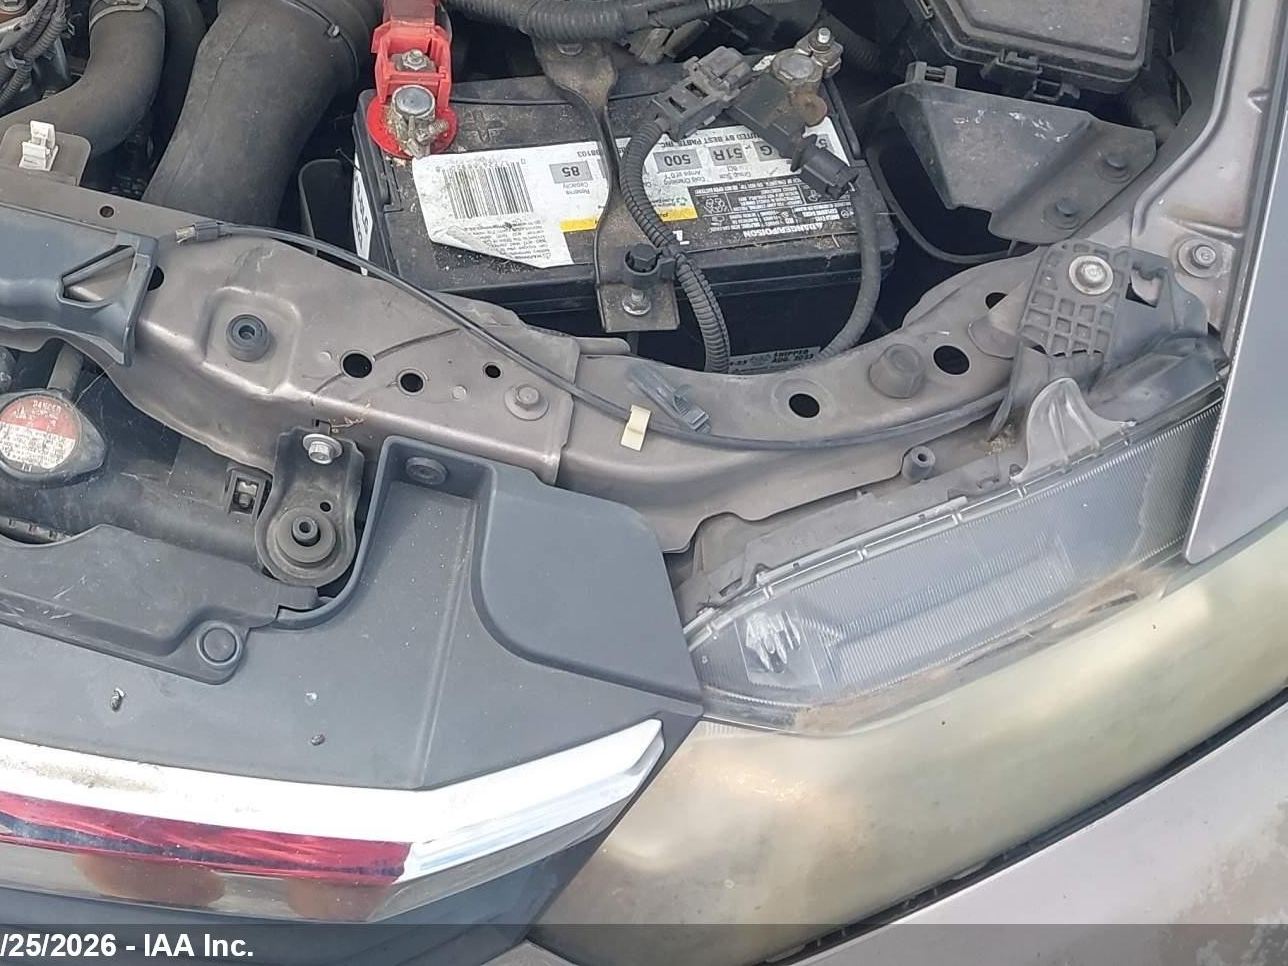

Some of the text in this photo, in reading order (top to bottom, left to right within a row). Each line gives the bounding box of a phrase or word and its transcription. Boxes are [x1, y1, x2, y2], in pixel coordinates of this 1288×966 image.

[703, 136, 723, 144] BEST
[663, 153, 691, 167] 500
[712, 147, 743, 161] 51R
[561, 166, 580, 178] 85
[562, 181, 589, 190] Capacity
[742, 223, 816, 238] DANGER/POISON
[33, 399, 62, 413] DANGER
